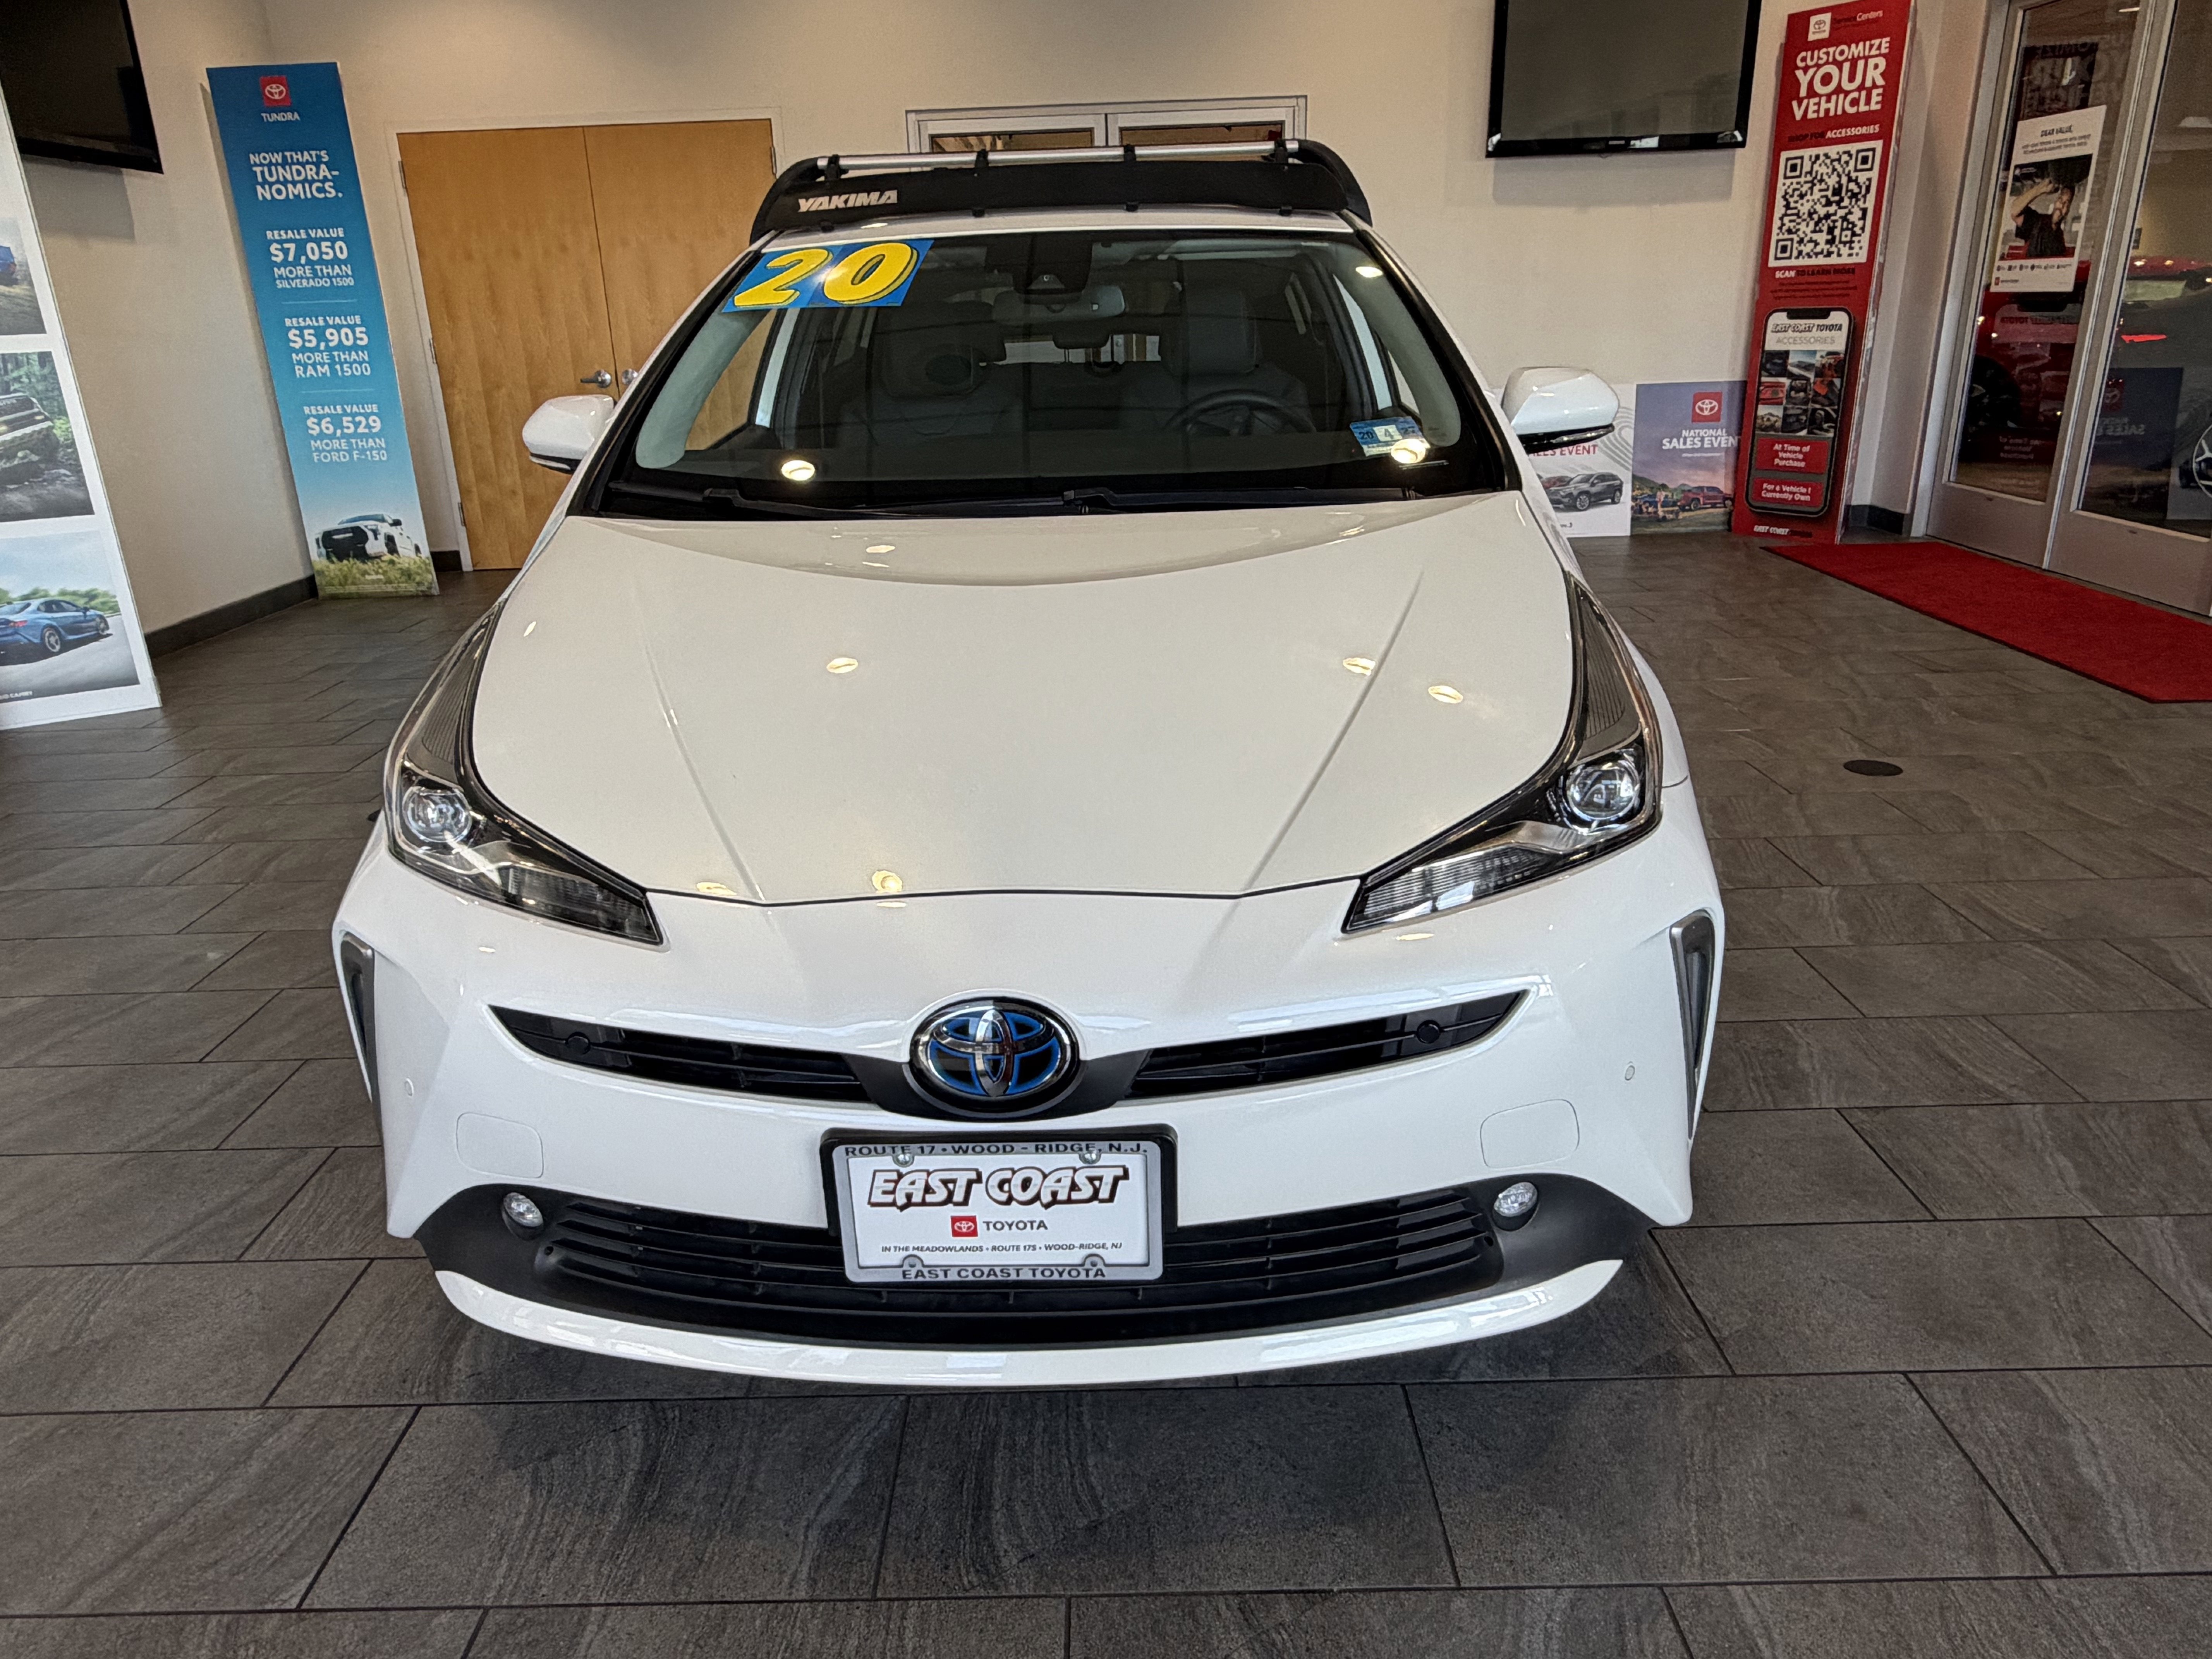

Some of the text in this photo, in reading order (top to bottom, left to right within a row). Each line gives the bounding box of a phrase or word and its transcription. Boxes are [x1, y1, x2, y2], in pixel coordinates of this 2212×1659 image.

[1796, 37, 1891, 67] CUSTOMIZE
[1795, 57, 1886, 97] YOUR
[1791, 88, 1883, 121] VEHICLE
[261, 112, 300, 122] TUNDRA
[1825, 124, 1880, 139] ACCESSORIES
[249, 150, 329, 164] NOW THAT'S
[252, 164, 339, 182] TUNDRA-
[256, 182, 343, 201] NOMICS.
[798, 190, 898, 212] YAKIMA
[266, 228, 344, 239] RESALE VALUE
[270, 241, 348, 264] $7,050
[273, 264, 352, 278] MORE THAN
[734, 242, 918, 308] 20
[1775, 270, 1796, 278] SCAN
[276, 276, 354, 289] SILVERADO 1500
[285, 315, 362, 327] RESALE VALUE
[1816, 323, 1843, 332] TOYOTA
[288, 327, 369, 349] $5,905
[1776, 336, 1835, 345] ACCESSORIES
[292, 350, 369, 364] MORE THAN
[295, 363, 371, 378] RAM 1500
[303, 404, 379, 415] RESALE VALUE
[307, 415, 381, 437] $6,529
[1682, 428, 1728, 437] NATIONAL
[1358, 431, 1374, 440] 20
[310, 438, 386, 450] MORE THAN
[1662, 437, 1702, 449] SALES
[313, 450, 387, 463] FORD F-150
[1560, 444, 1598, 456] EVENT
[1774, 459, 1805, 467] Purchase
[1762, 491, 1793, 500] Currently
[1782, 485, 1807, 493] Vehicle
[845, 1145, 911, 1156] ROUTE
[917, 1145, 936, 1154] 17
[951, 1144, 1015, 1154] WOOD
[1108, 1143, 1147, 1153] N.J.
[867, 1165, 1130, 1212] EAST COAST
[982, 1220, 1048, 1231] TOYOTA
[902, 1268, 1105, 1279] EAST COAST TOYOTA
